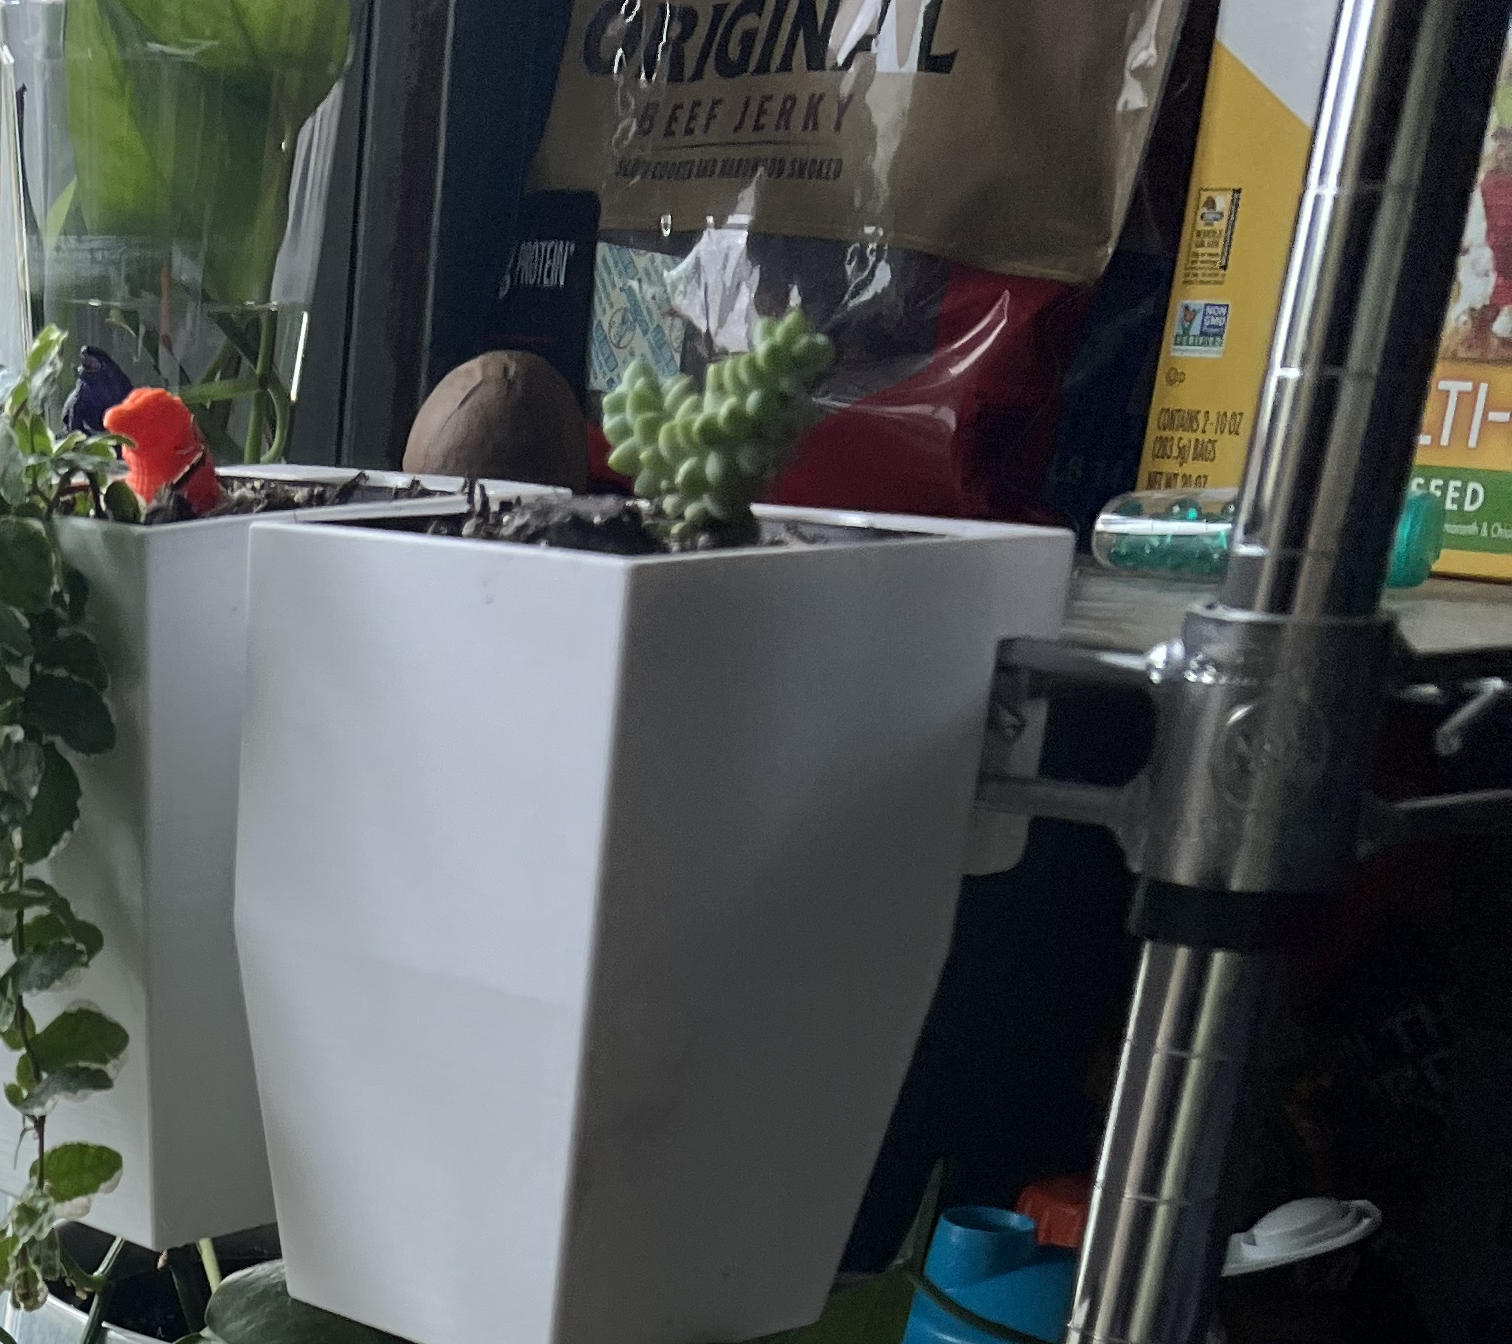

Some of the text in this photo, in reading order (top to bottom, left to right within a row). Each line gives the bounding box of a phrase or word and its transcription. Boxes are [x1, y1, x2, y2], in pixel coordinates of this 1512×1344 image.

[638, 92, 854, 138] BEEF JERKY
[1419, 380, 1511, 449] TI-
